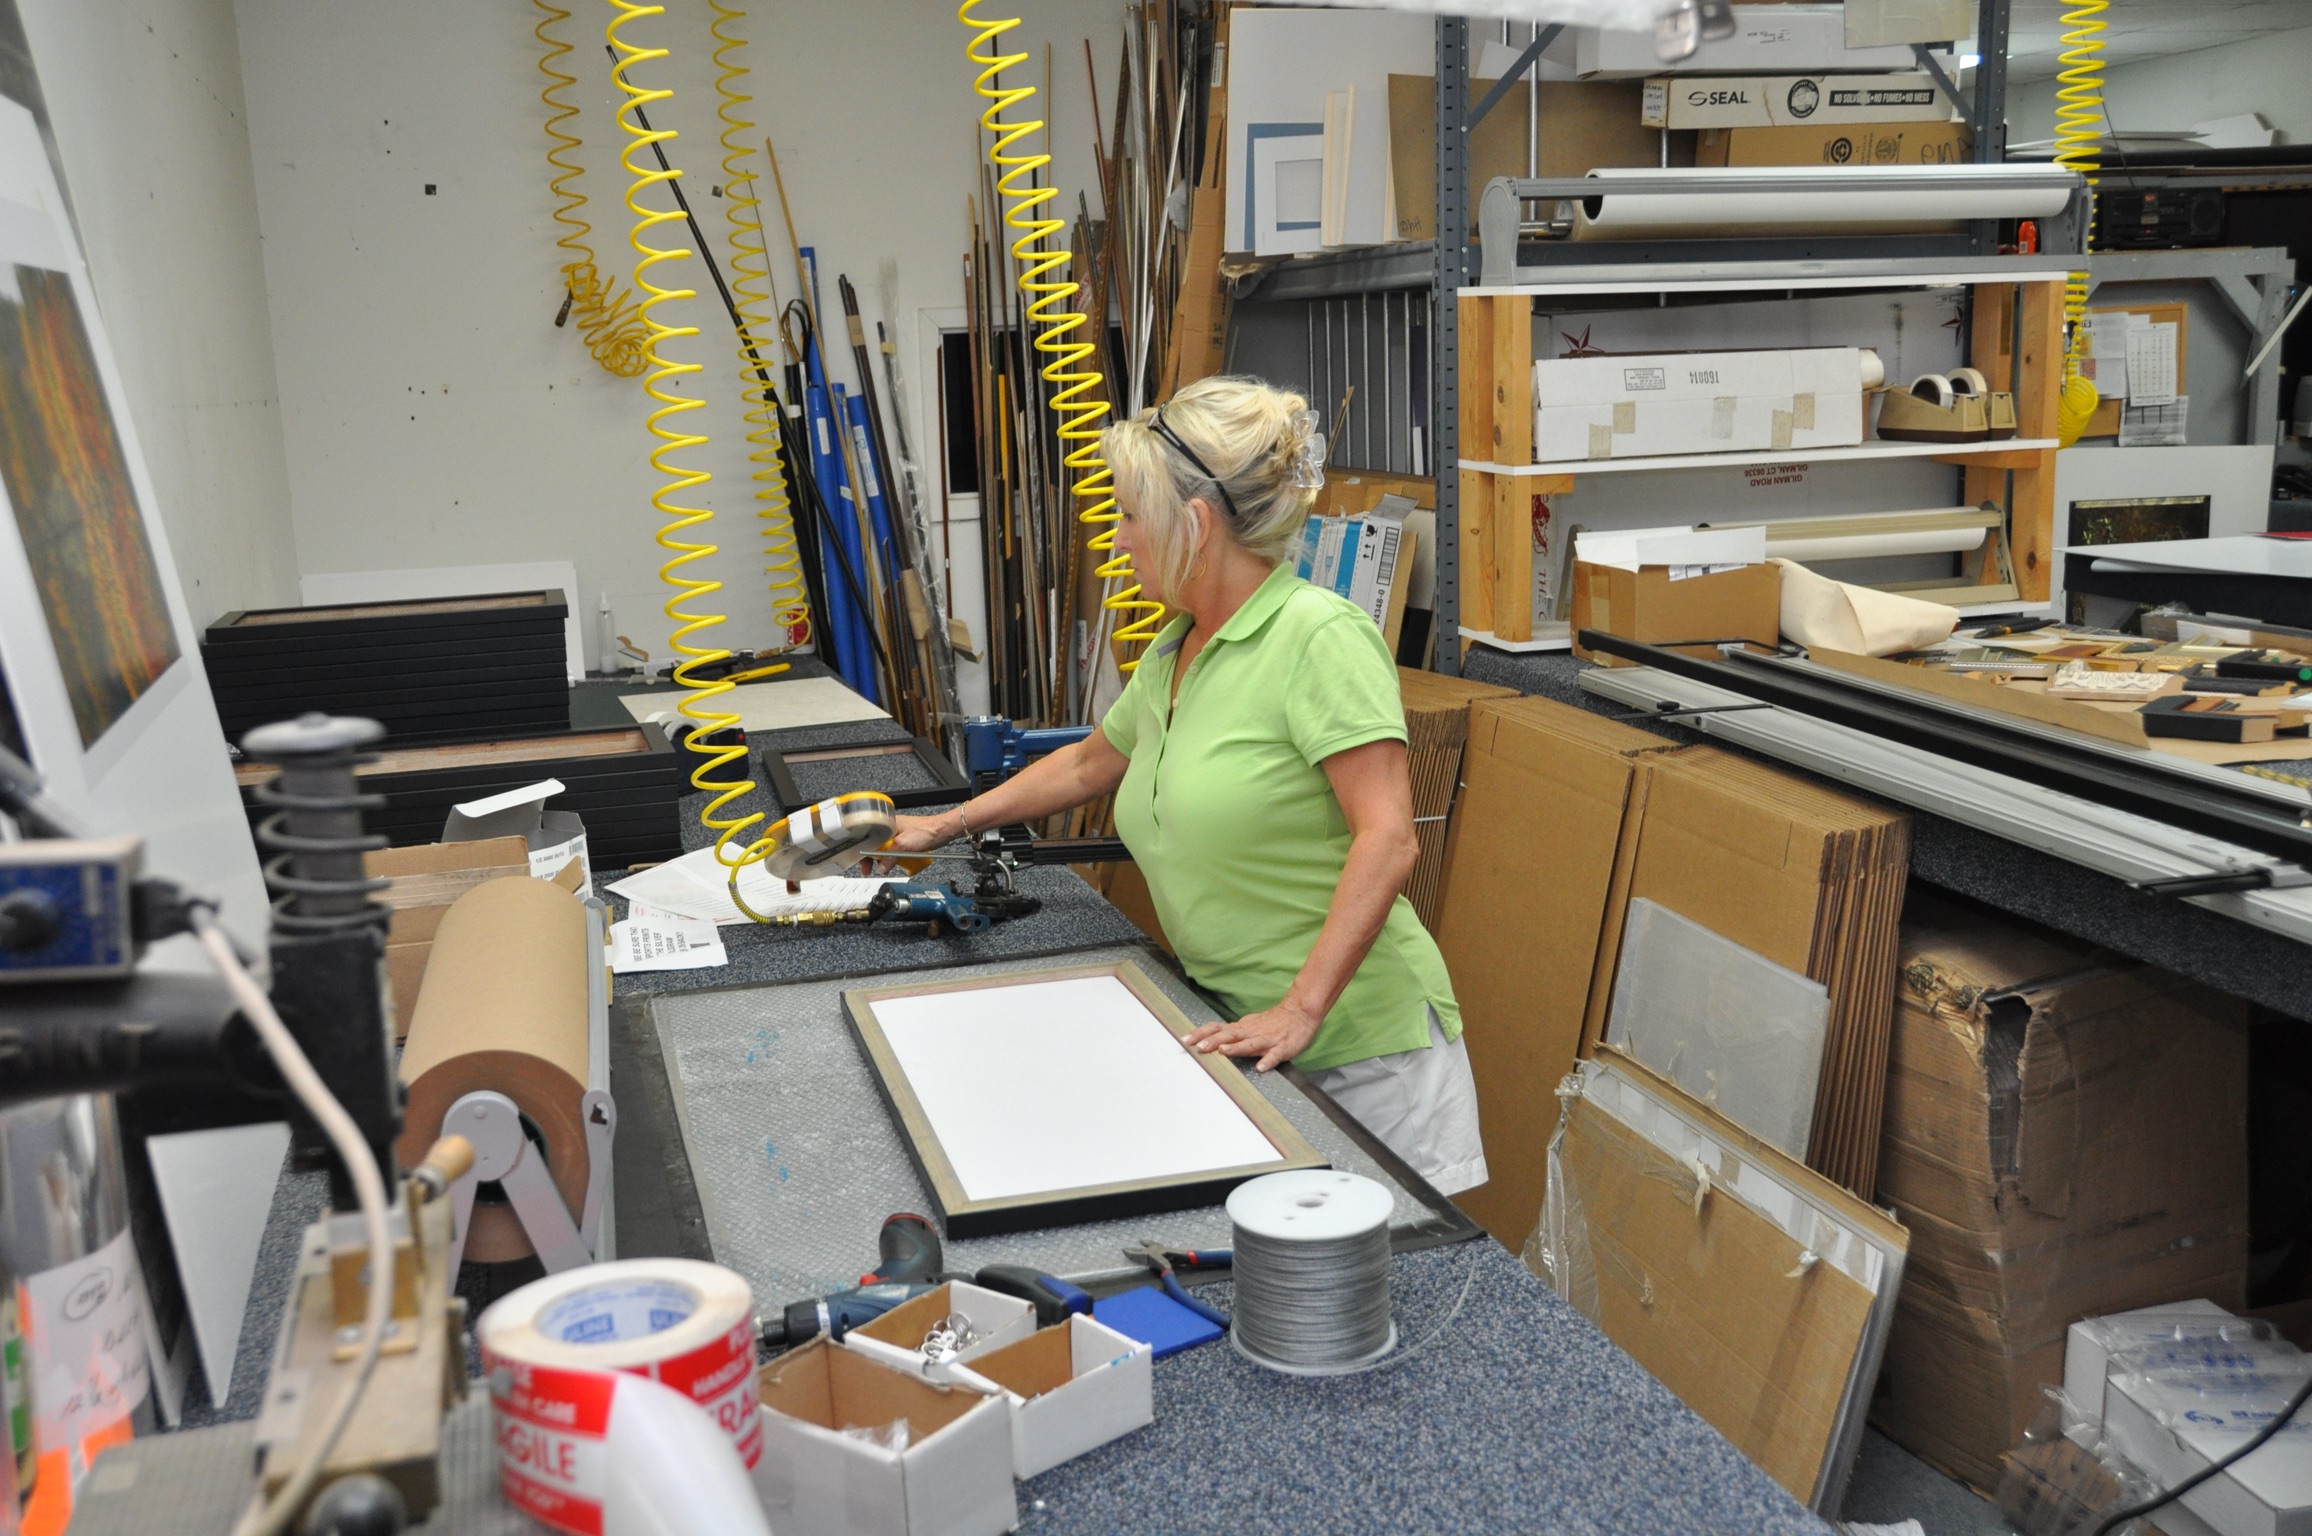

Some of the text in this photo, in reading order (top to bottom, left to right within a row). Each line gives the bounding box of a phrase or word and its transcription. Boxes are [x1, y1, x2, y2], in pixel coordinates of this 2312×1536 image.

[1709, 91, 1748, 105] SEAL
[1833, 93, 1843, 104] NO
[1913, 92, 1931, 103] MESS
[1766, 467, 1777, 475] CT
[1750, 474, 1803, 487] GILMAN ROAD
